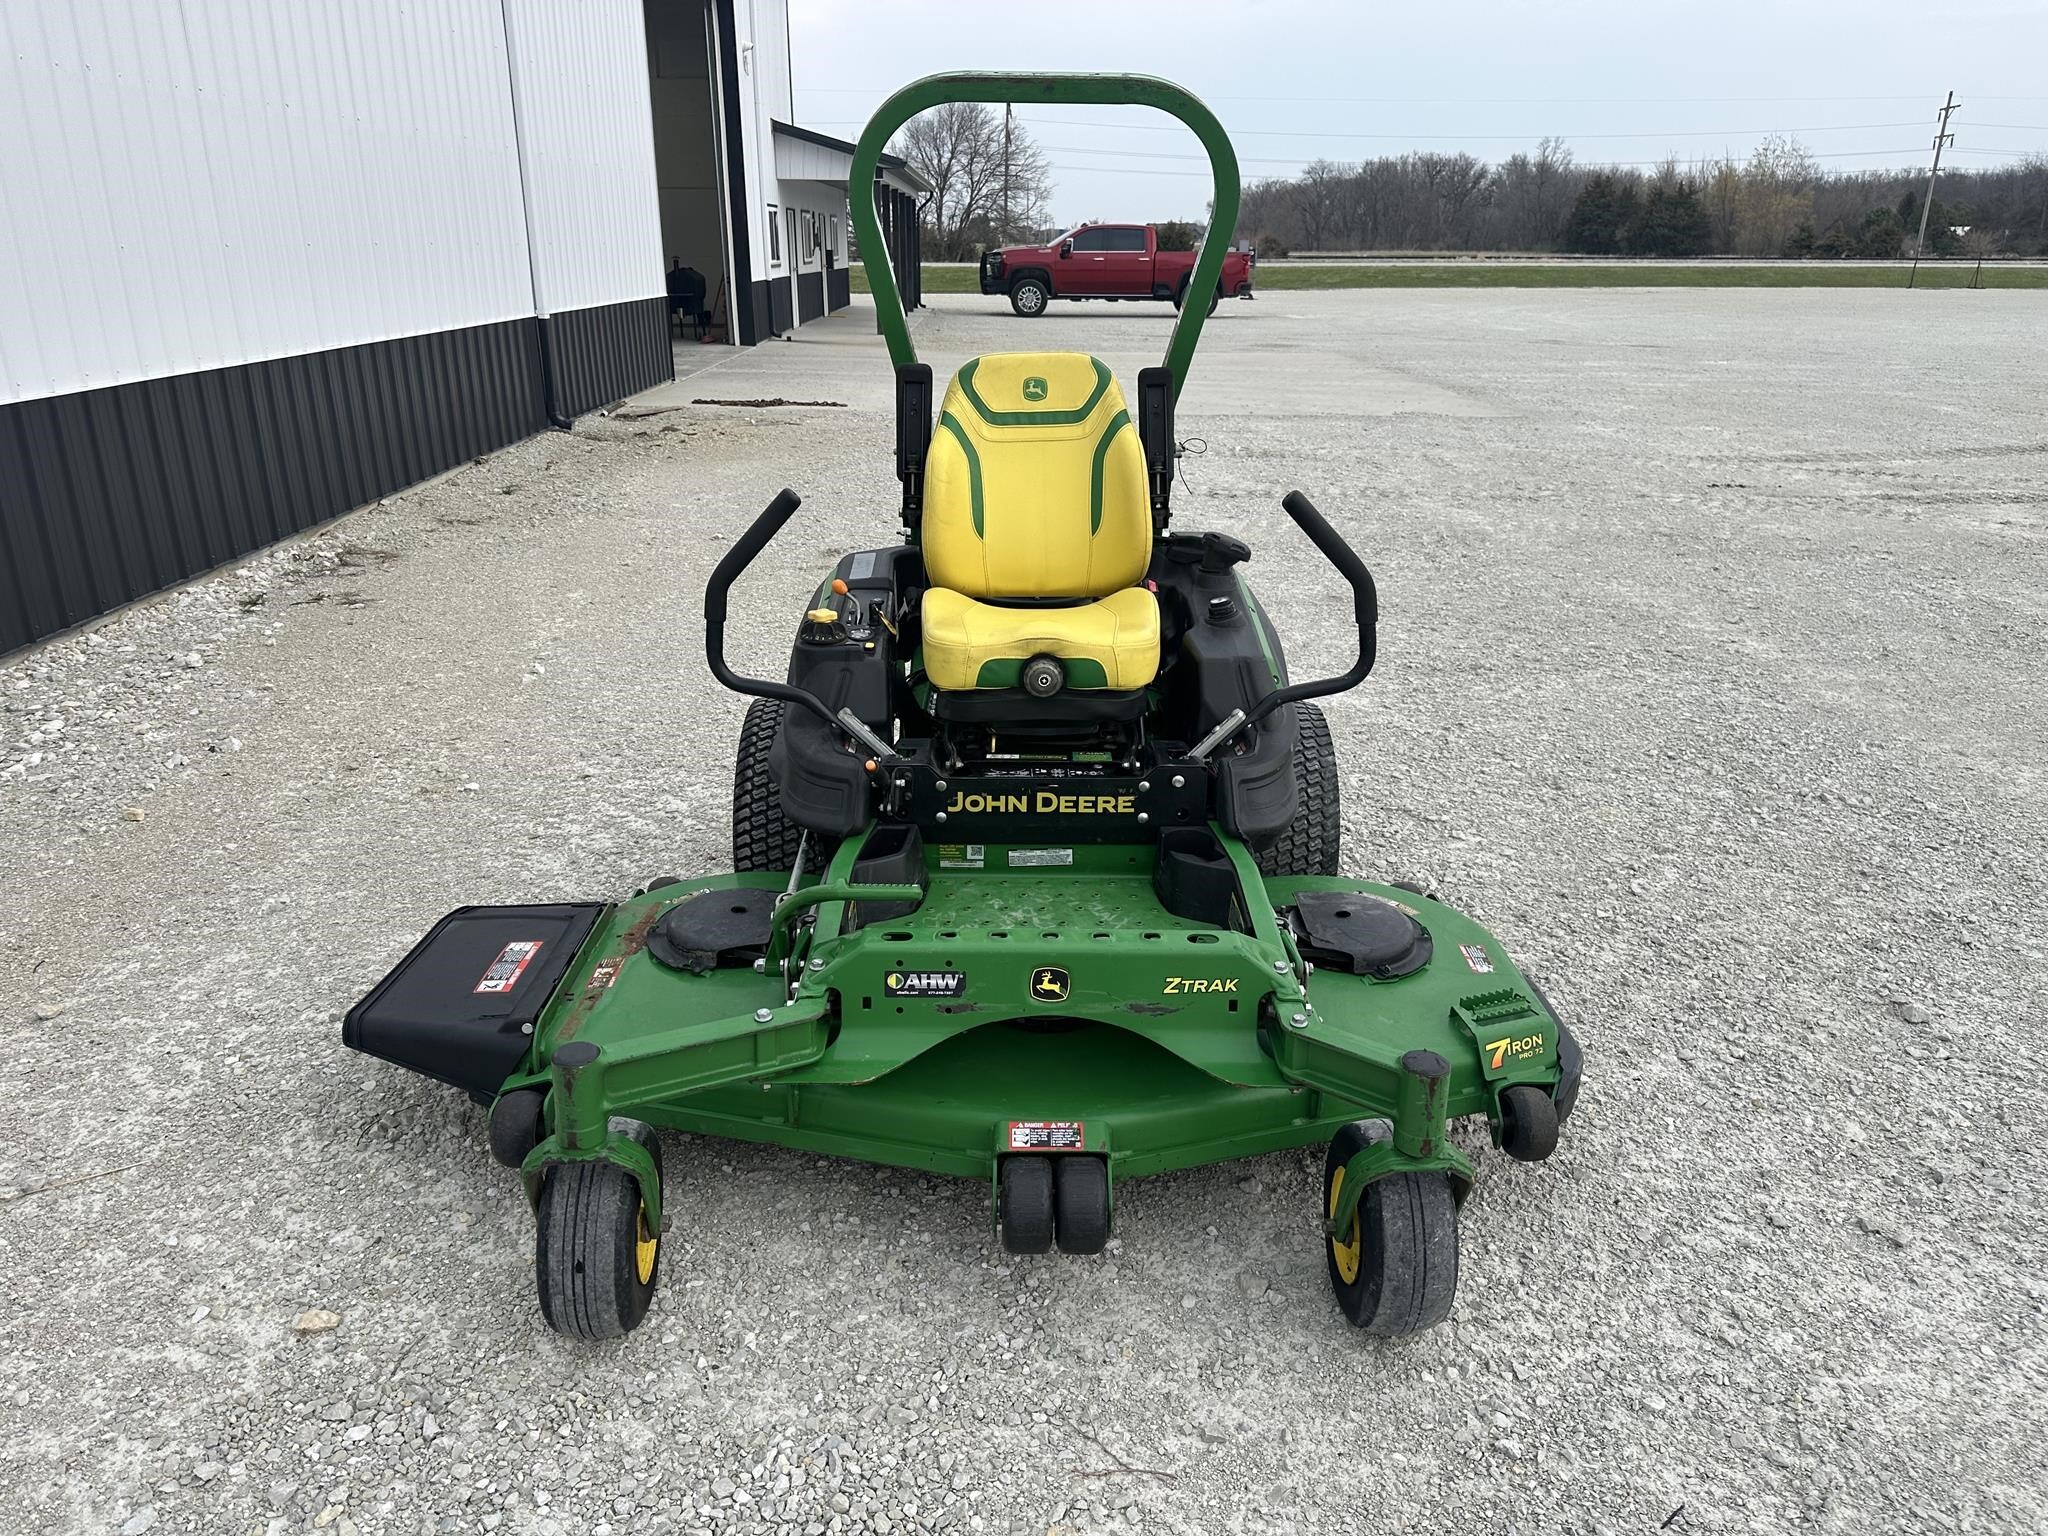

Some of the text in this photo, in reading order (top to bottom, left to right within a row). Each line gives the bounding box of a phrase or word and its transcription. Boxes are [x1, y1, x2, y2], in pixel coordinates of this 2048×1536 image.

[948, 791, 1135, 813] JOHN DEERE
[903, 973, 959, 989] AHW
[1163, 977, 1240, 994] ZTRAK
[1518, 1047, 1544, 1060] PRO 72
